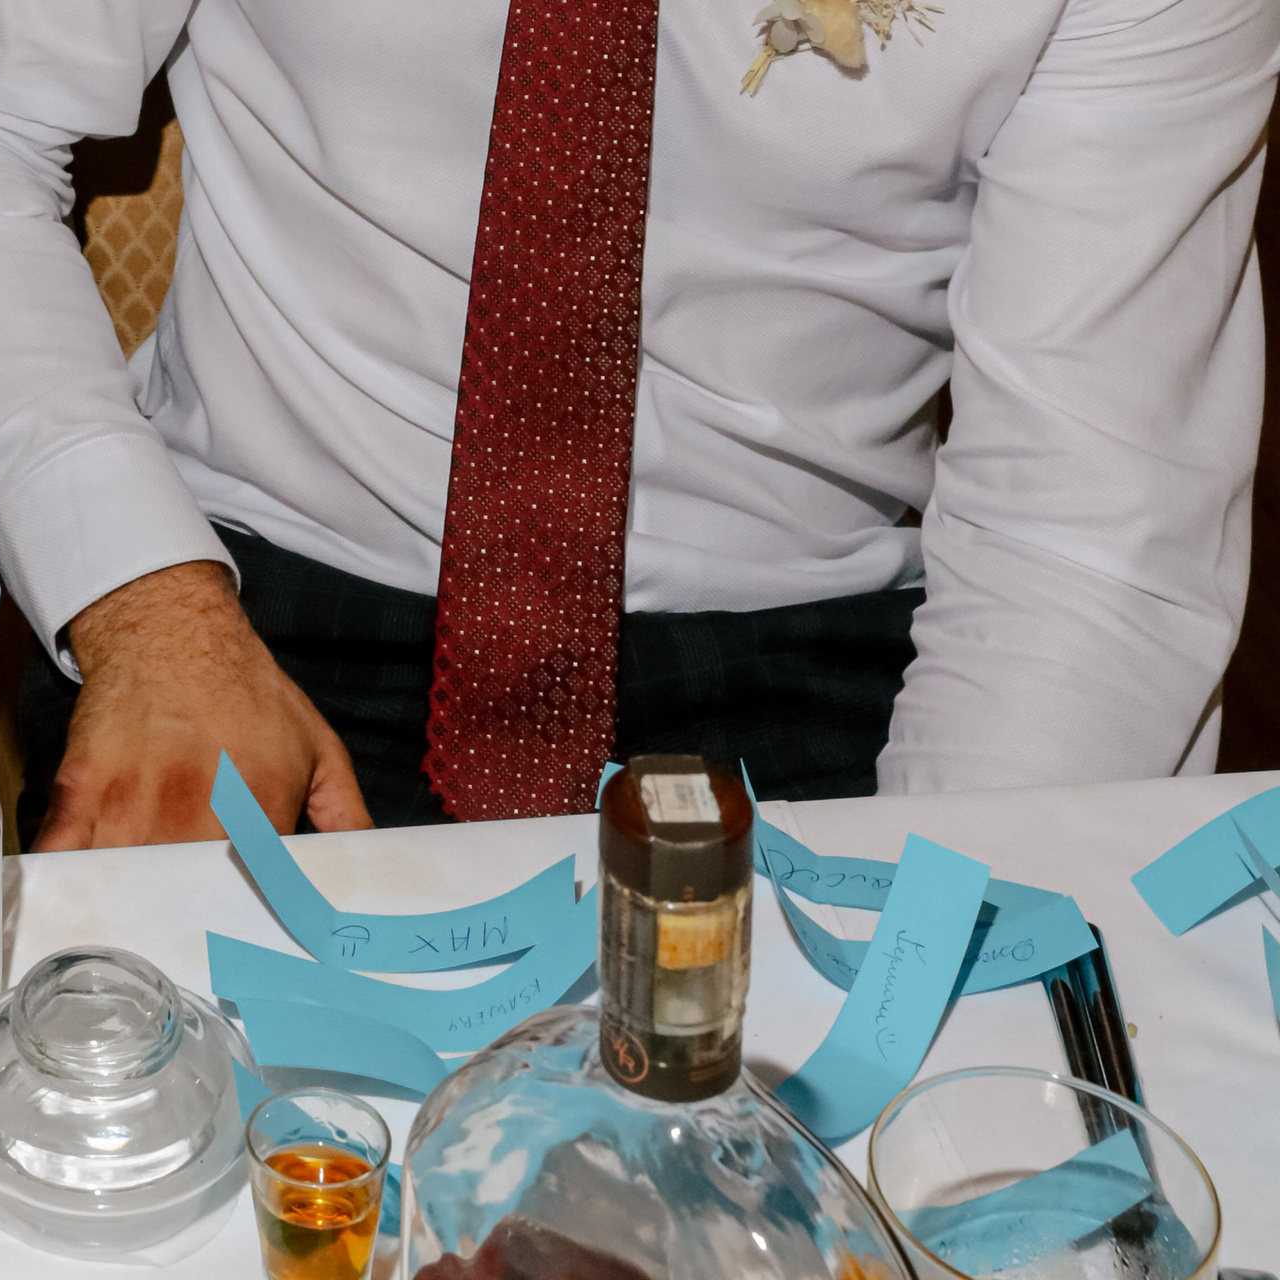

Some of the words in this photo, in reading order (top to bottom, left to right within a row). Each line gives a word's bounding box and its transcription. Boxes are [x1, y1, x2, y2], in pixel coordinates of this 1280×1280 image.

[767, 848, 893, 891] arcel
[407, 915, 509, 954] MAX
[448, 977, 542, 1033] KSAWERY
